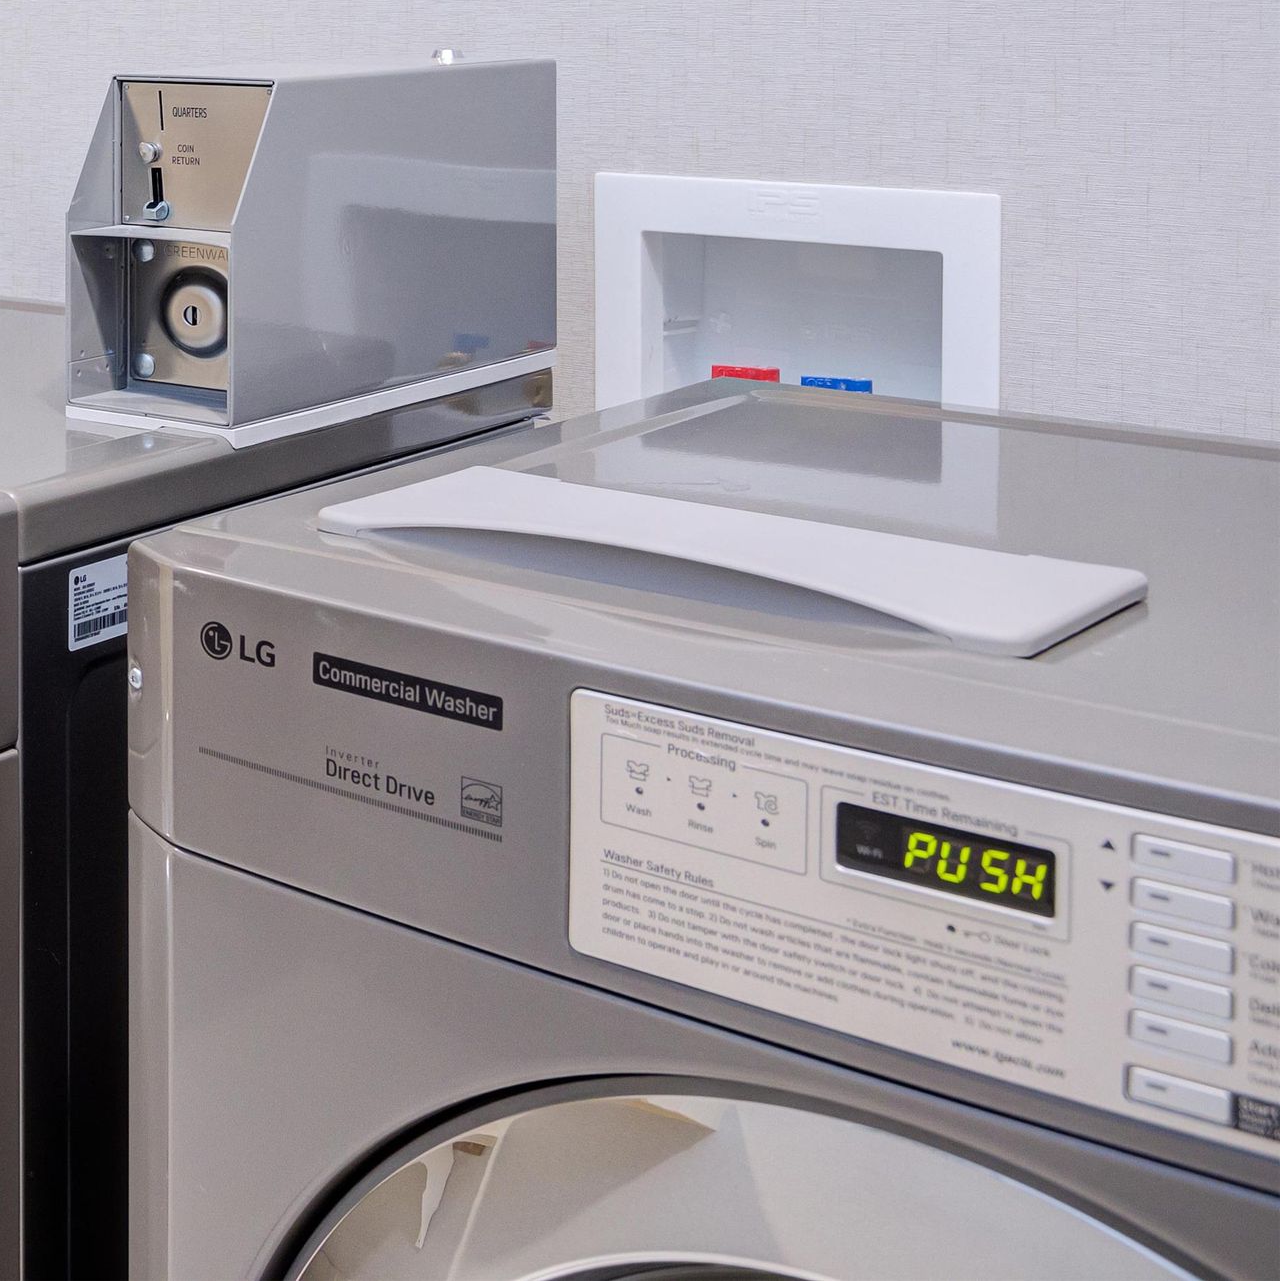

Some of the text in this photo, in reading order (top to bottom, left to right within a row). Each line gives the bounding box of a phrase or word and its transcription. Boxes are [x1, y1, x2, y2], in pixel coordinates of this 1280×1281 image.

[172, 106, 208, 119] QUARTERS
[171, 156, 200, 166] RETURN
[177, 144, 195, 154] COIN
[240, 634, 276, 668] LG
[319, 660, 497, 722] Commercial Washer
[678, 721, 703, 736] Suds
[707, 727, 754, 747] Removal
[325, 744, 380, 769] Inverter
[667, 744, 736, 771] Processing
[325, 757, 435, 806] Direct Drive
[625, 802, 652, 817] Wash
[904, 799, 936, 817] Time
[941, 807, 1018, 838] Remaining
[688, 819, 713, 834] Rinse
[755, 836, 777, 850] Spin
[603, 848, 714, 888] Washer Safety Rules
[904, 832, 1048, 901] PUSH
[602, 881, 623, 895] drum
[626, 888, 640, 900] has
[642, 895, 664, 907] come
[624, 875, 637, 885] not
[640, 880, 661, 892] open
[664, 885, 676, 896] the
[679, 888, 697, 902] door
[700, 896, 719, 908] until
[723, 901, 736, 913] the
[602, 910, 619, 923] door
[633, 920, 655, 934] place
[658, 926, 683, 942] hands
[671, 918, 684, 928] not
[602, 926, 634, 943] children
[648, 940, 680, 956] operate
